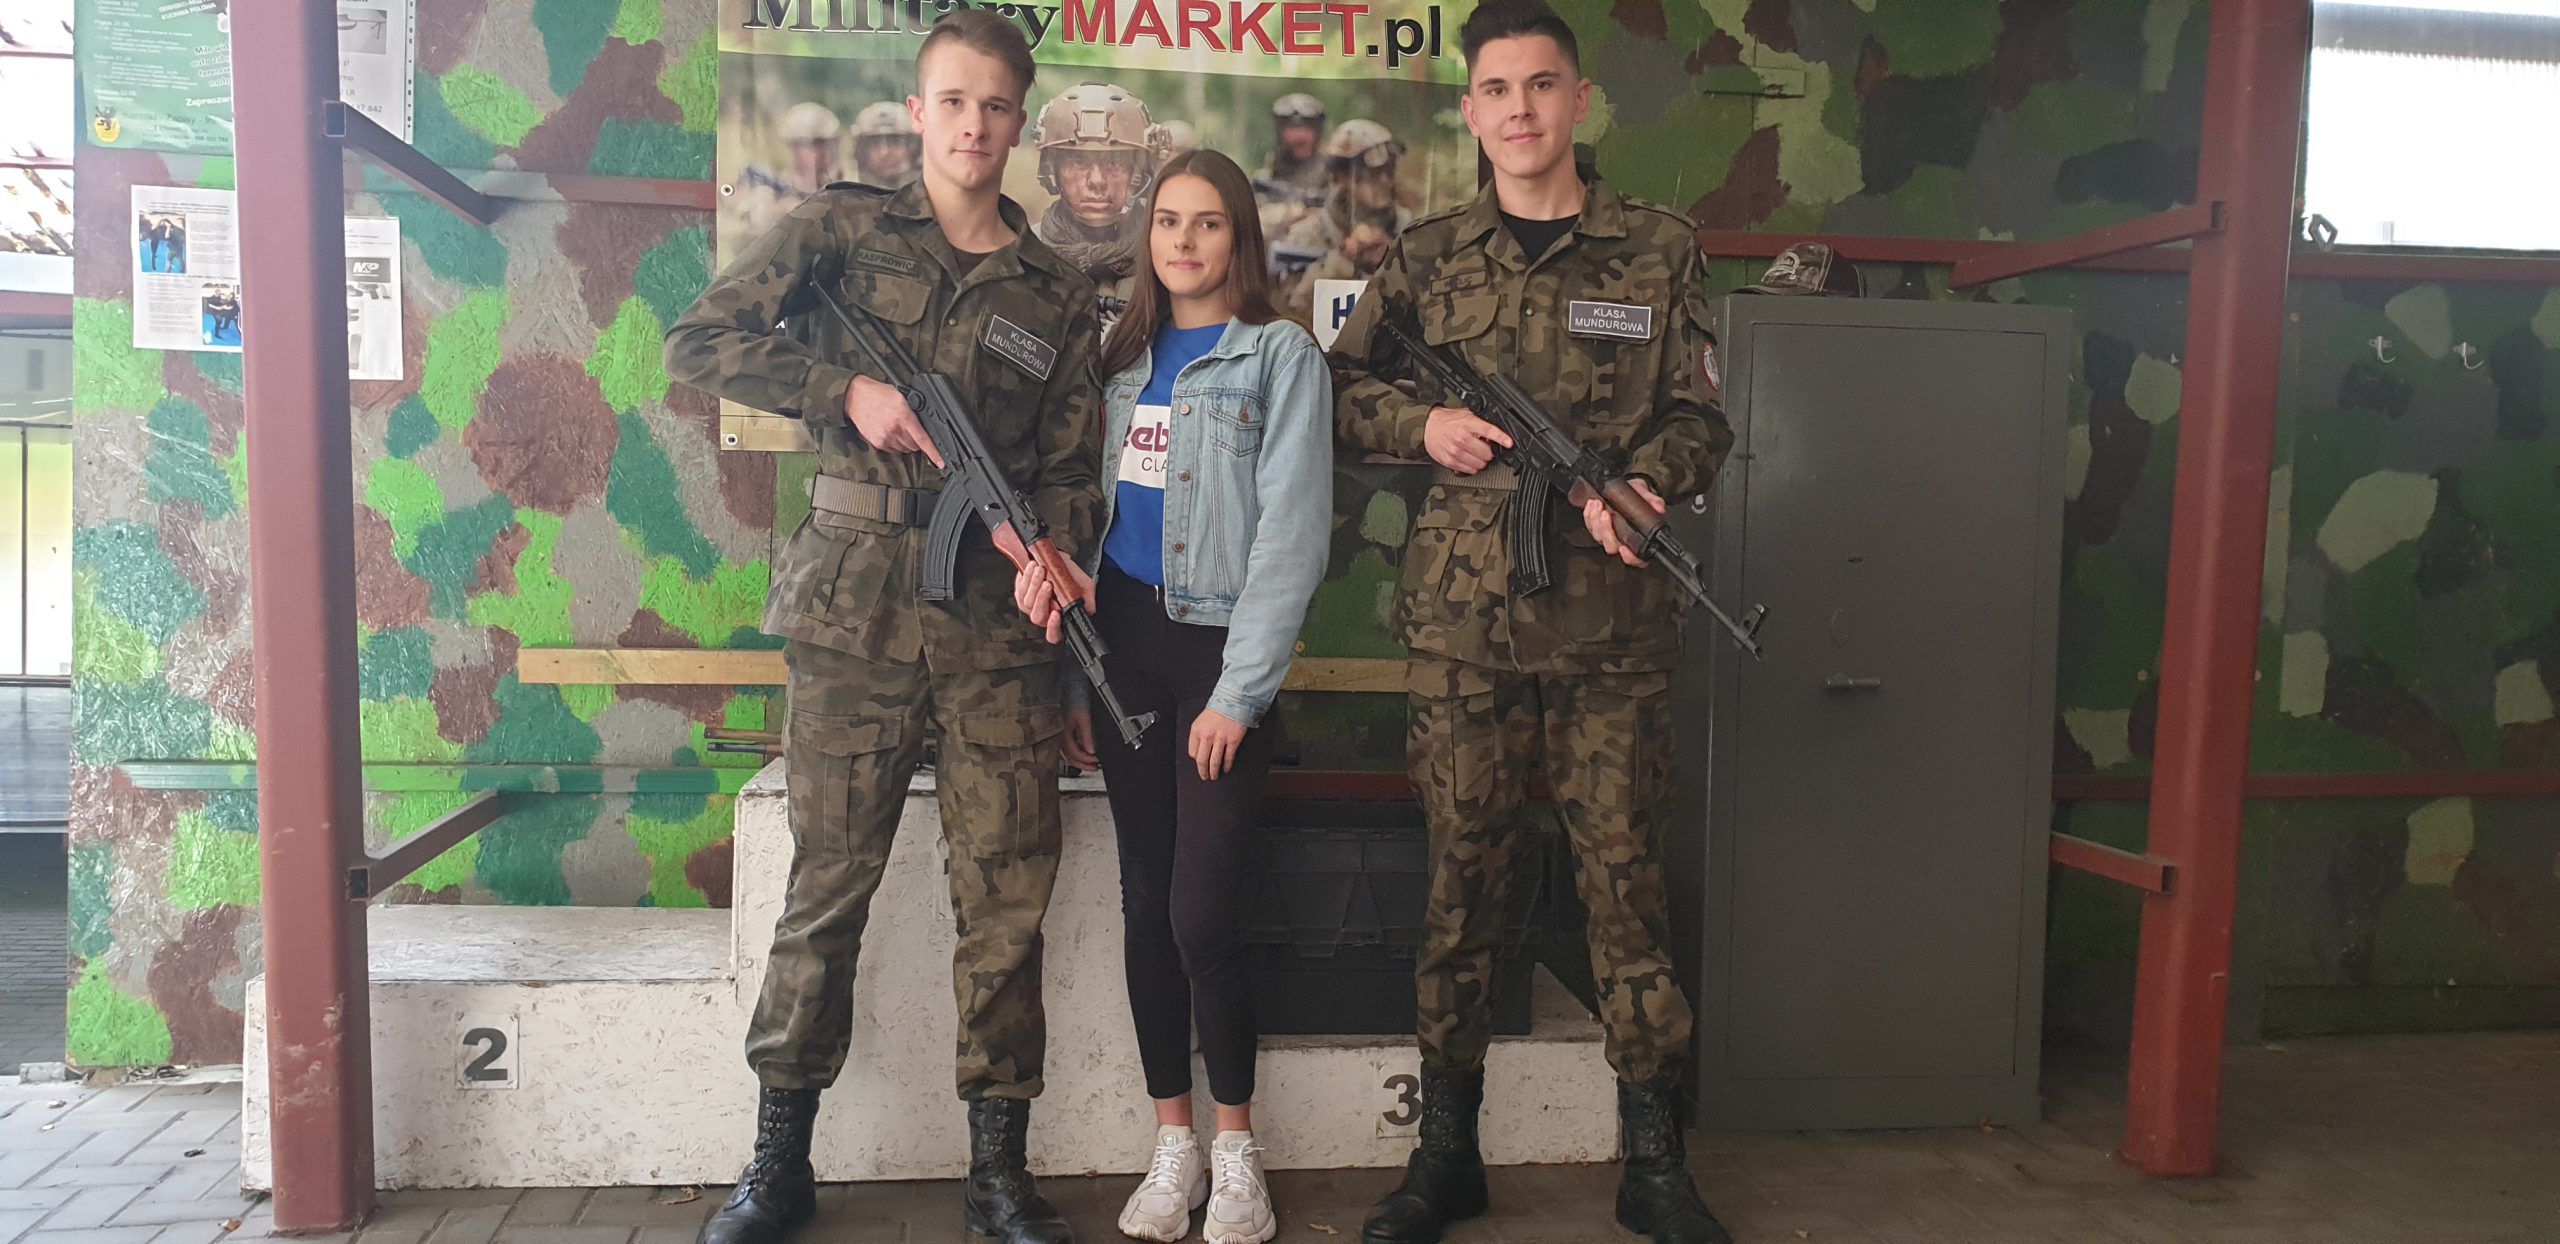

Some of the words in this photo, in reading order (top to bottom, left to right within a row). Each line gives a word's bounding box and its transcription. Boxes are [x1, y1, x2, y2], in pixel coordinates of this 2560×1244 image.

[857, 250, 917, 271] KASPROWIC
[1593, 307, 1627, 319] KLASA
[1574, 318, 1644, 333] MUNDUROWA
[991, 333, 1046, 372] MUNDUROWA
[1010, 331, 1037, 353] KLASA
[463, 1027, 508, 1081] 2
[1382, 1073, 1423, 1126] 3
